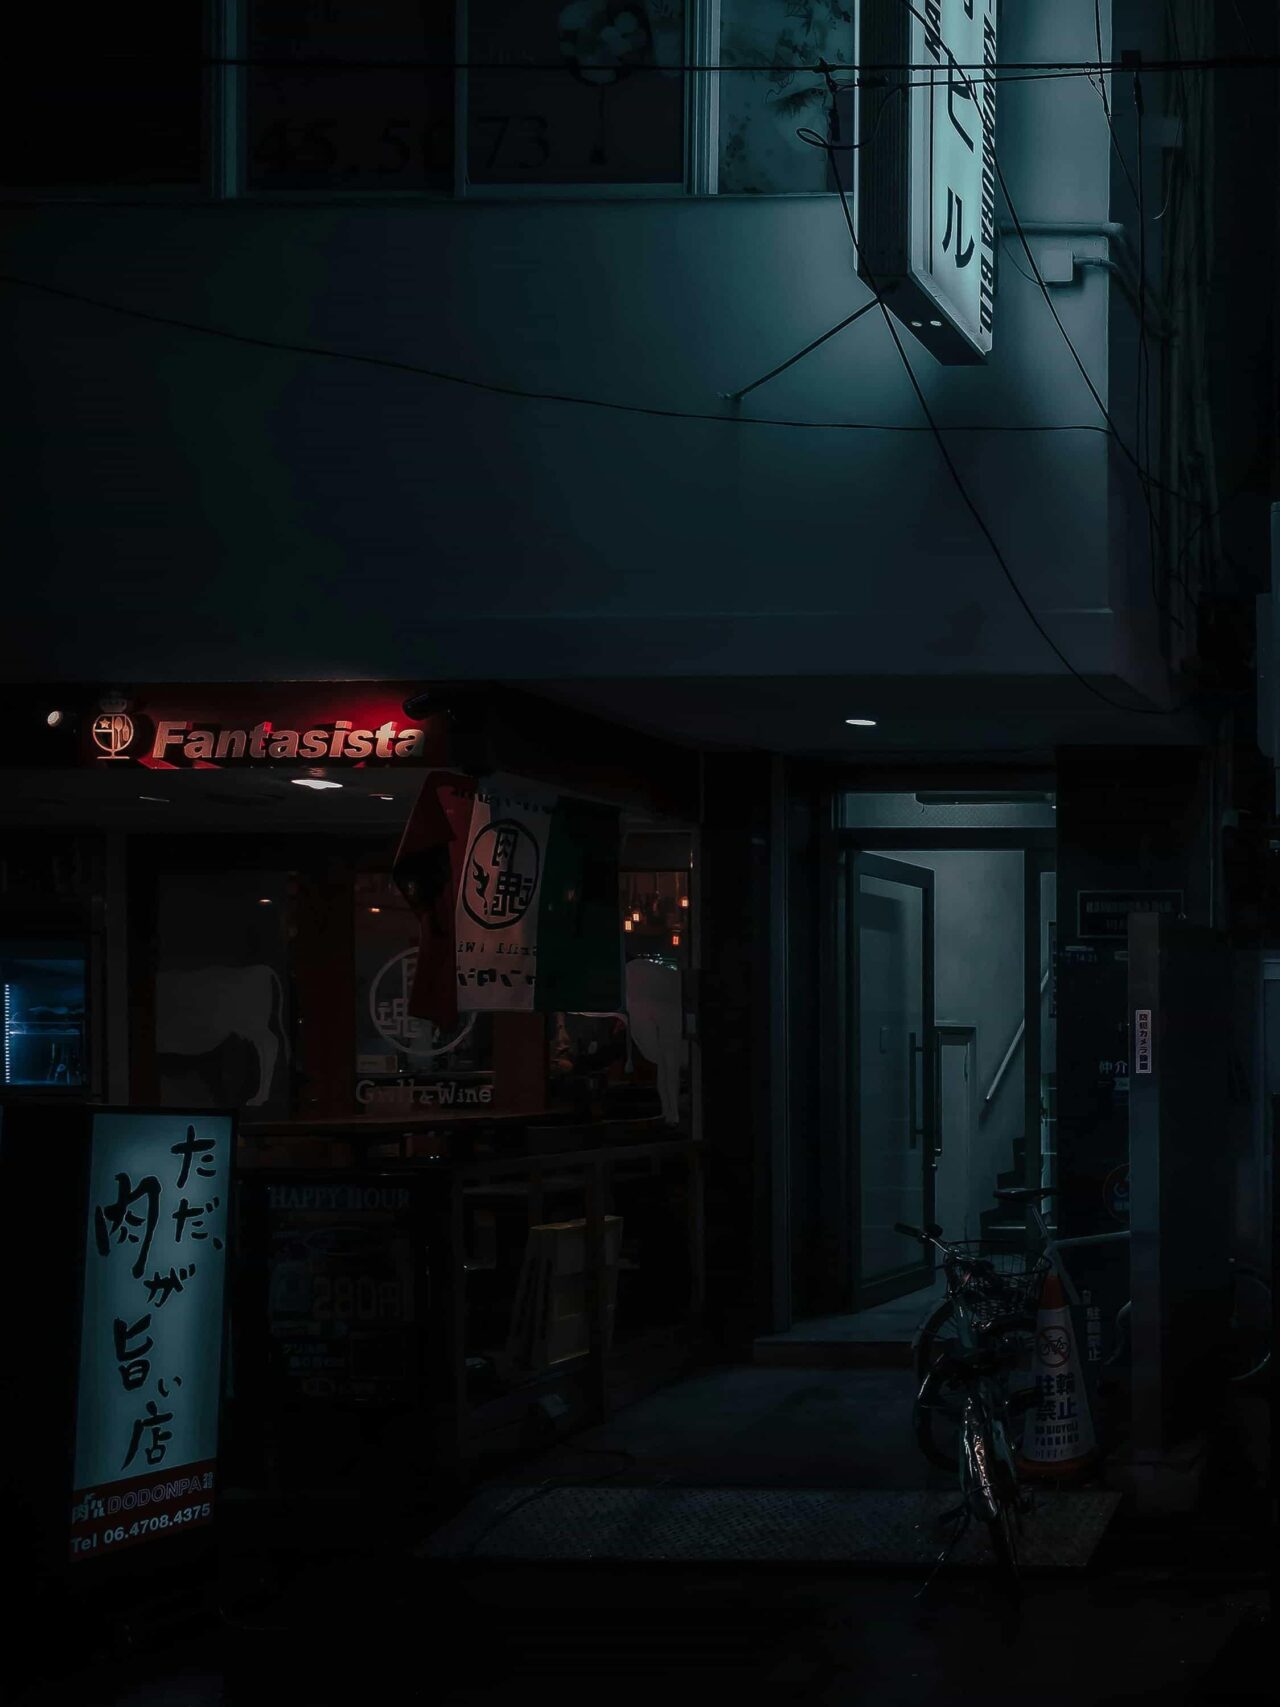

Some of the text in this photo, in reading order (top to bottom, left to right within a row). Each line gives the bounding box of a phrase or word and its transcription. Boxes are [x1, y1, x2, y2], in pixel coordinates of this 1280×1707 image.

[979, 13, 997, 335] KAWAMURA BLD.
[151, 719, 426, 760] Fantasista
[269, 1186, 411, 1209] HAPPY HOUR
[106, 1474, 202, 1515] DODONPA
[70, 1503, 212, 1554] Tel 06.4708.4375
